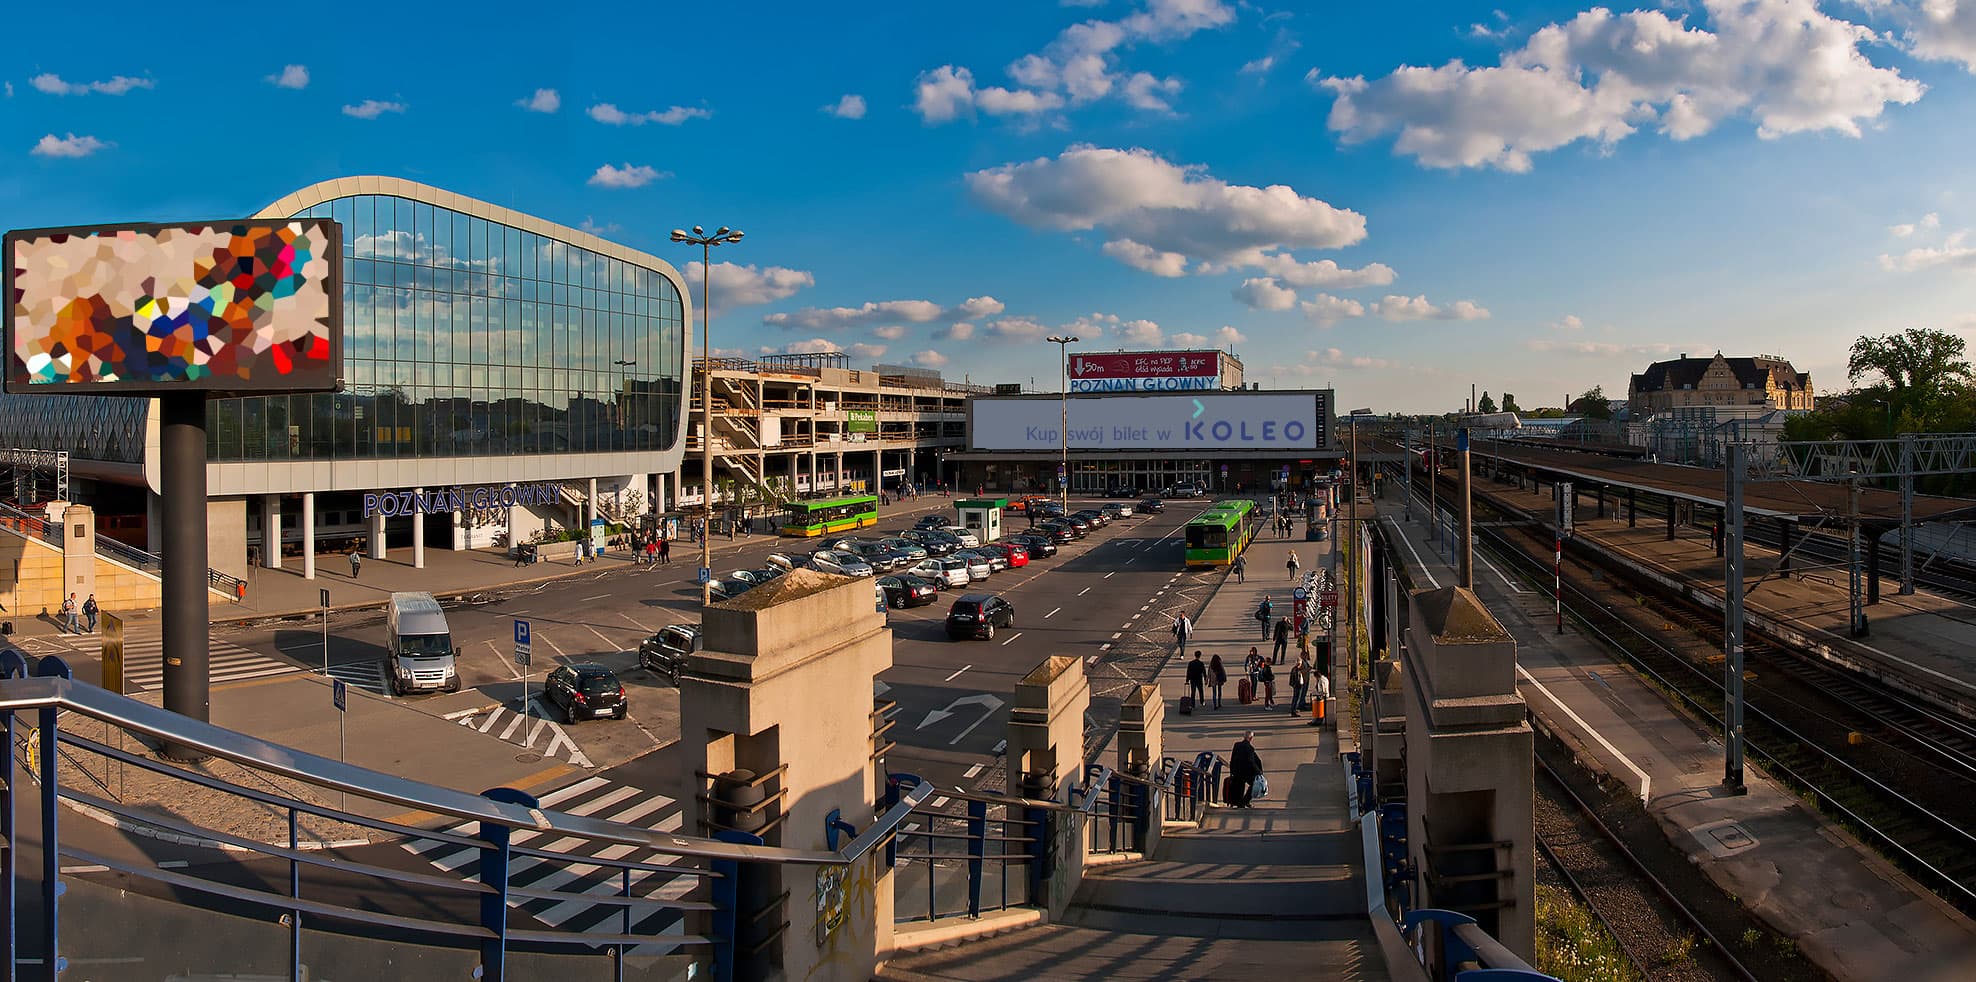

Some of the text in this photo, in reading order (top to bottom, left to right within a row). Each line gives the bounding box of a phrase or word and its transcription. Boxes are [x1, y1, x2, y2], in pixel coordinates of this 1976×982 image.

[1086, 362, 1104, 373] 50m
[1026, 420, 1305, 446] Kup swój bilet w KOLEO
[363, 482, 563, 519] POZNAŃ GŁÓWNY
[517, 622, 528, 641] P
